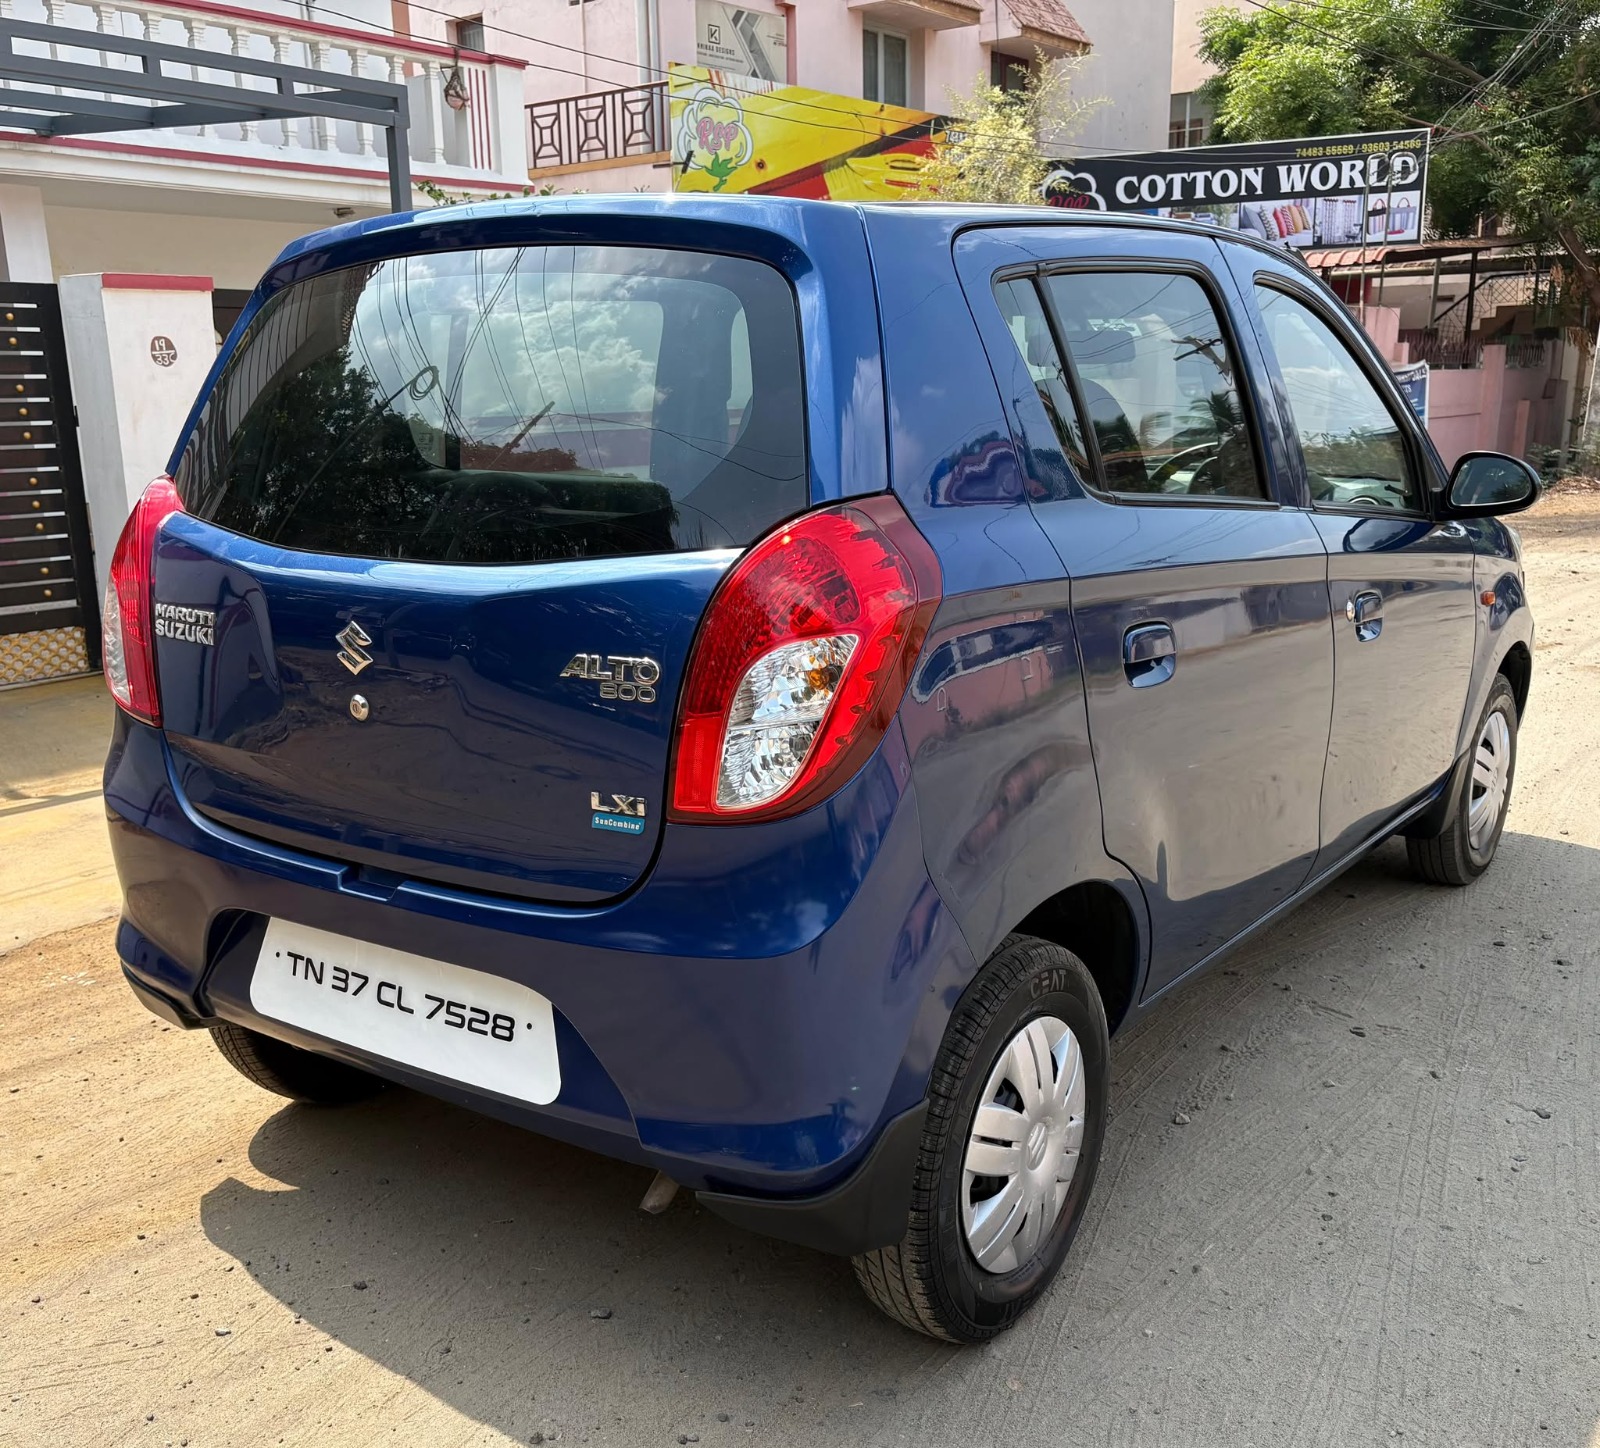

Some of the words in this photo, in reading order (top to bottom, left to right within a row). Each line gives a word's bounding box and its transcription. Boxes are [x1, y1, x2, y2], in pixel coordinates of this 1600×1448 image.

[1115, 166, 1265, 204] COTTON
[1276, 156, 1420, 193] WORLD
[154, 338, 167, 351] 19
[155, 603, 216, 625] MARUTI
[155, 618, 215, 646] SUZUKI
[559, 653, 660, 685] ALTO
[600, 682, 656, 703] 800
[287, 951, 324, 985] TN
[331, 965, 369, 996] 37
[376, 981, 415, 1015] CL
[424, 993, 515, 1043] 7528
[1030, 969, 1067, 999] CEAT
